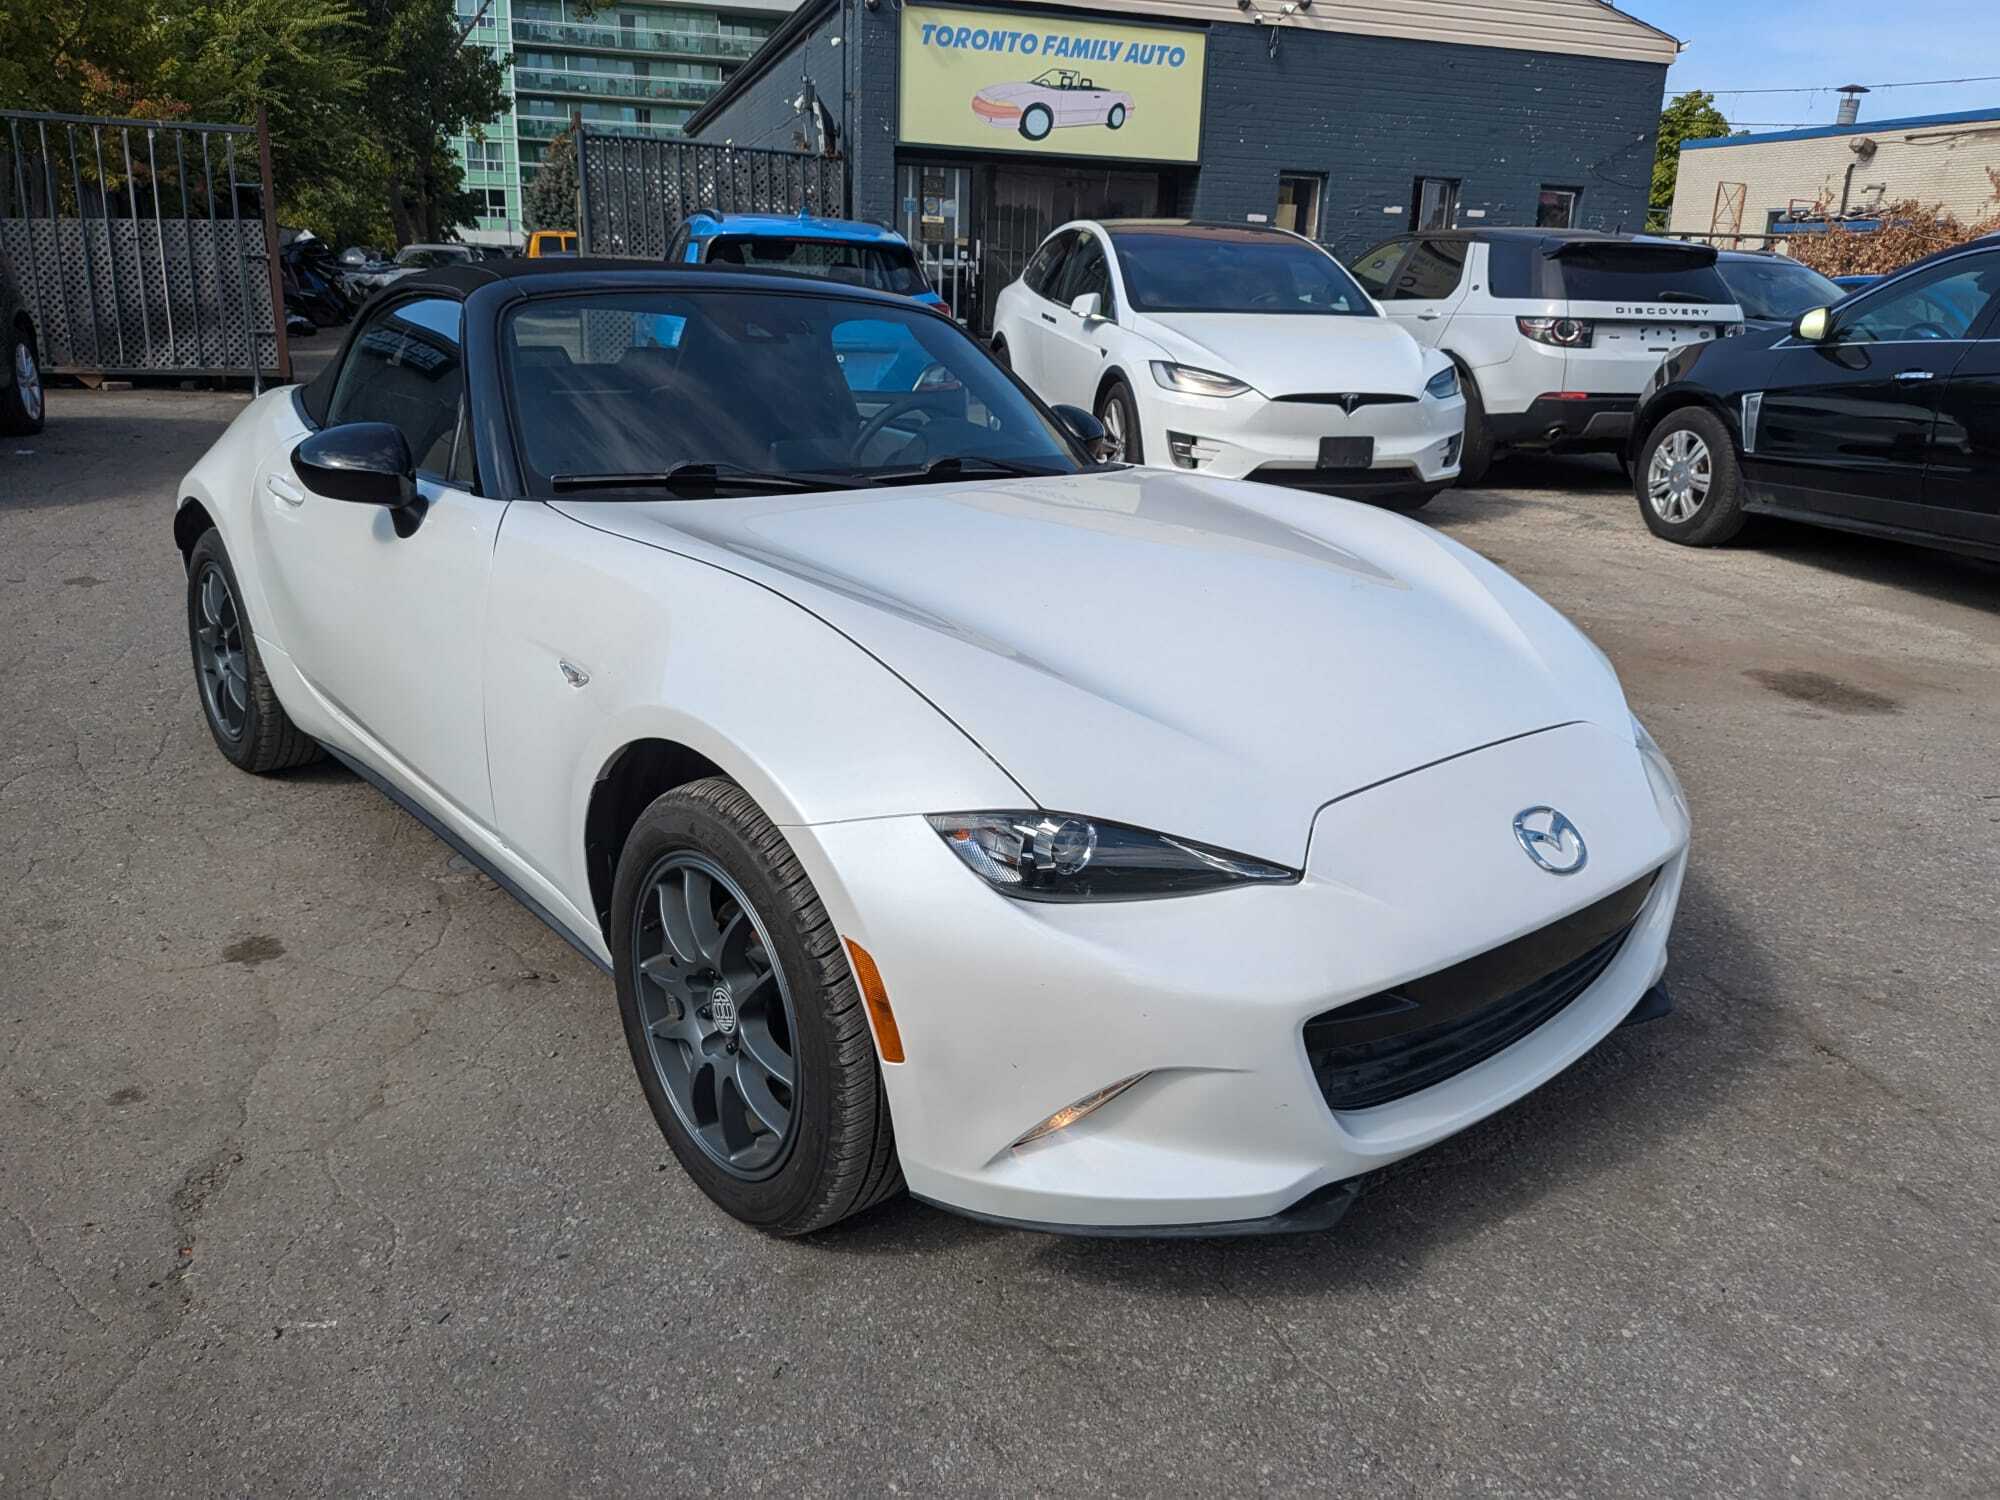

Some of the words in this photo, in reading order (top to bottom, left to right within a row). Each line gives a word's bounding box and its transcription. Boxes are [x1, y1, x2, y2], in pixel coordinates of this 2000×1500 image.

[921, 24, 1038, 55] TORONTO
[1041, 35, 1123, 62] FAMILY
[1124, 43, 1186, 68] AUTO
[1615, 306, 1709, 317] DISCOVERY
